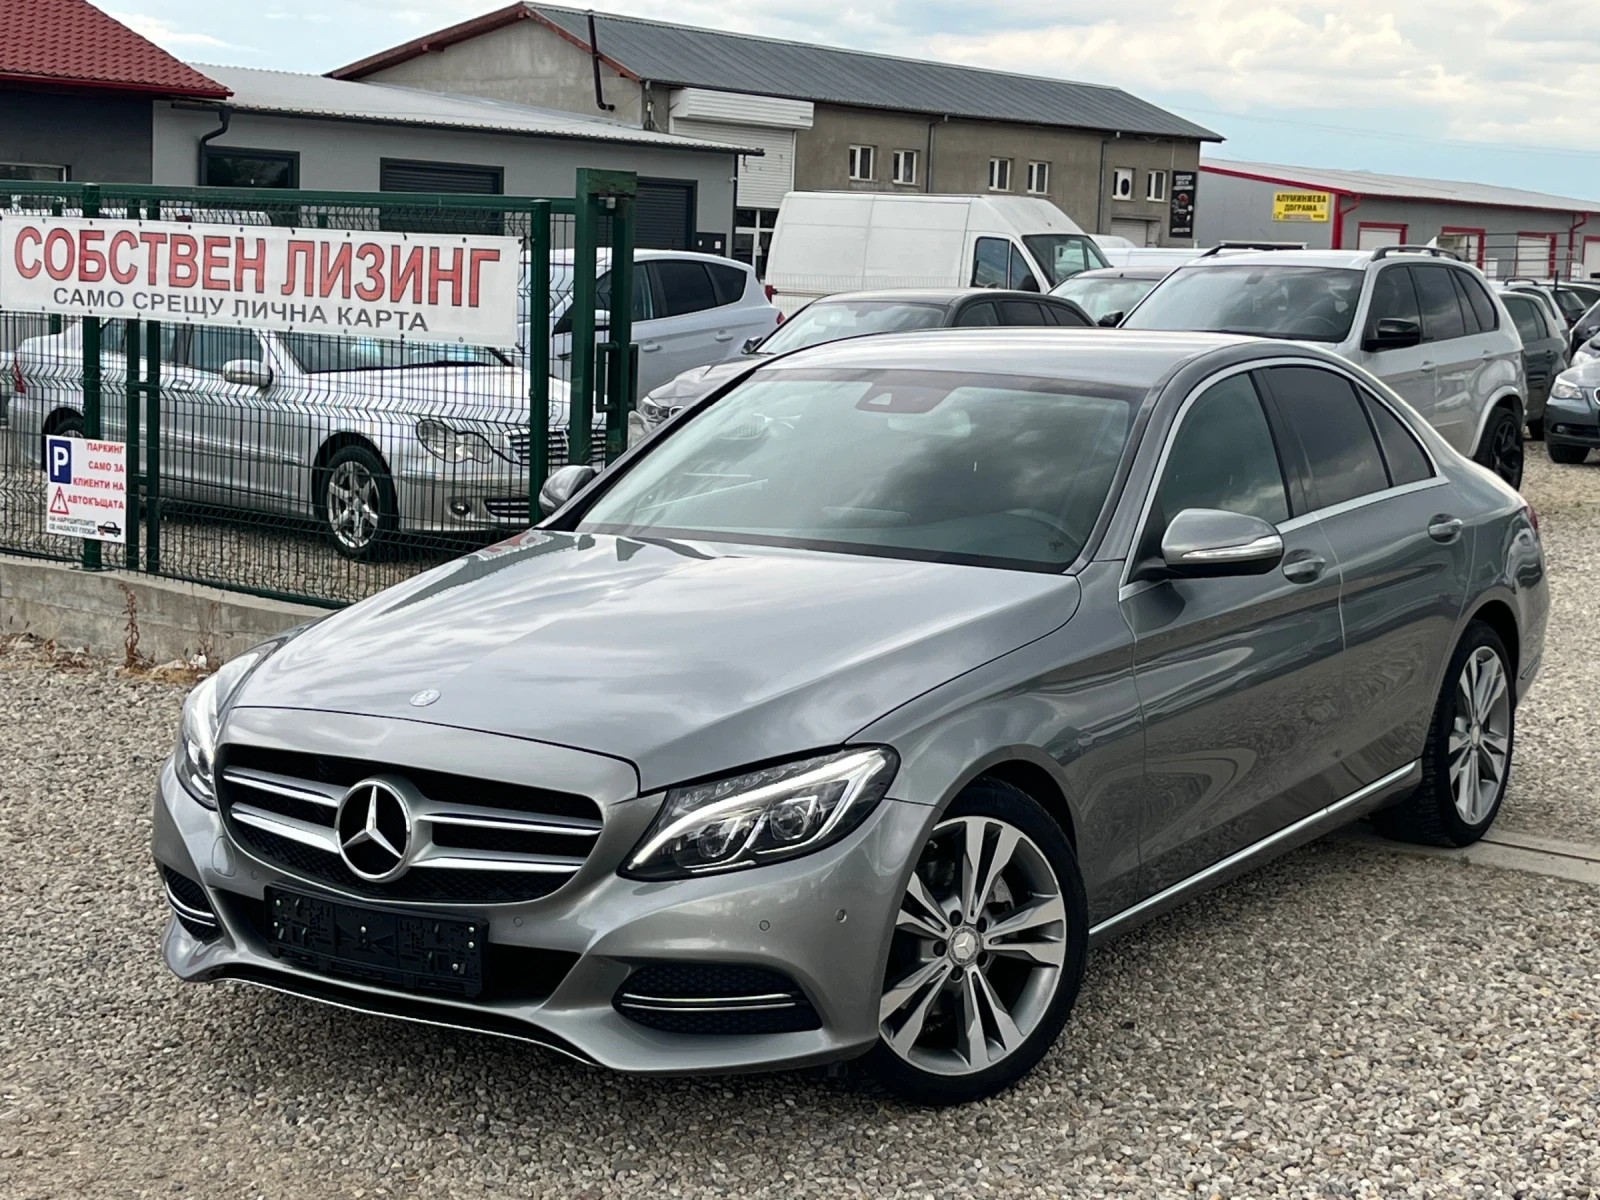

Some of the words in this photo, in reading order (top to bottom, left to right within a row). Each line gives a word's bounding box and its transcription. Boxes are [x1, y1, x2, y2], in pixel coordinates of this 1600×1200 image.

[1276, 194, 1327, 203] АЛУМИНИЕВА
[1284, 204, 1317, 212] ДОГРАМА
[14, 226, 266, 294] СОБСТВЕН
[281, 240, 501, 308] ЛИЗИНГ
[52, 286, 125, 309] САМО
[132, 291, 224, 316] СРЕЩУ
[232, 299, 328, 325] ЛИЧНА
[338, 307, 429, 332] КАРТА
[87, 443, 124, 454] ПАРКИНГ
[88, 461, 111, 471] САМО
[114, 464, 124, 473] ЗА
[73, 478, 110, 488] КЛИЕНТИ
[113, 482, 124, 491] НА
[68, 495, 124, 509] АВТОКЪЩАТА
